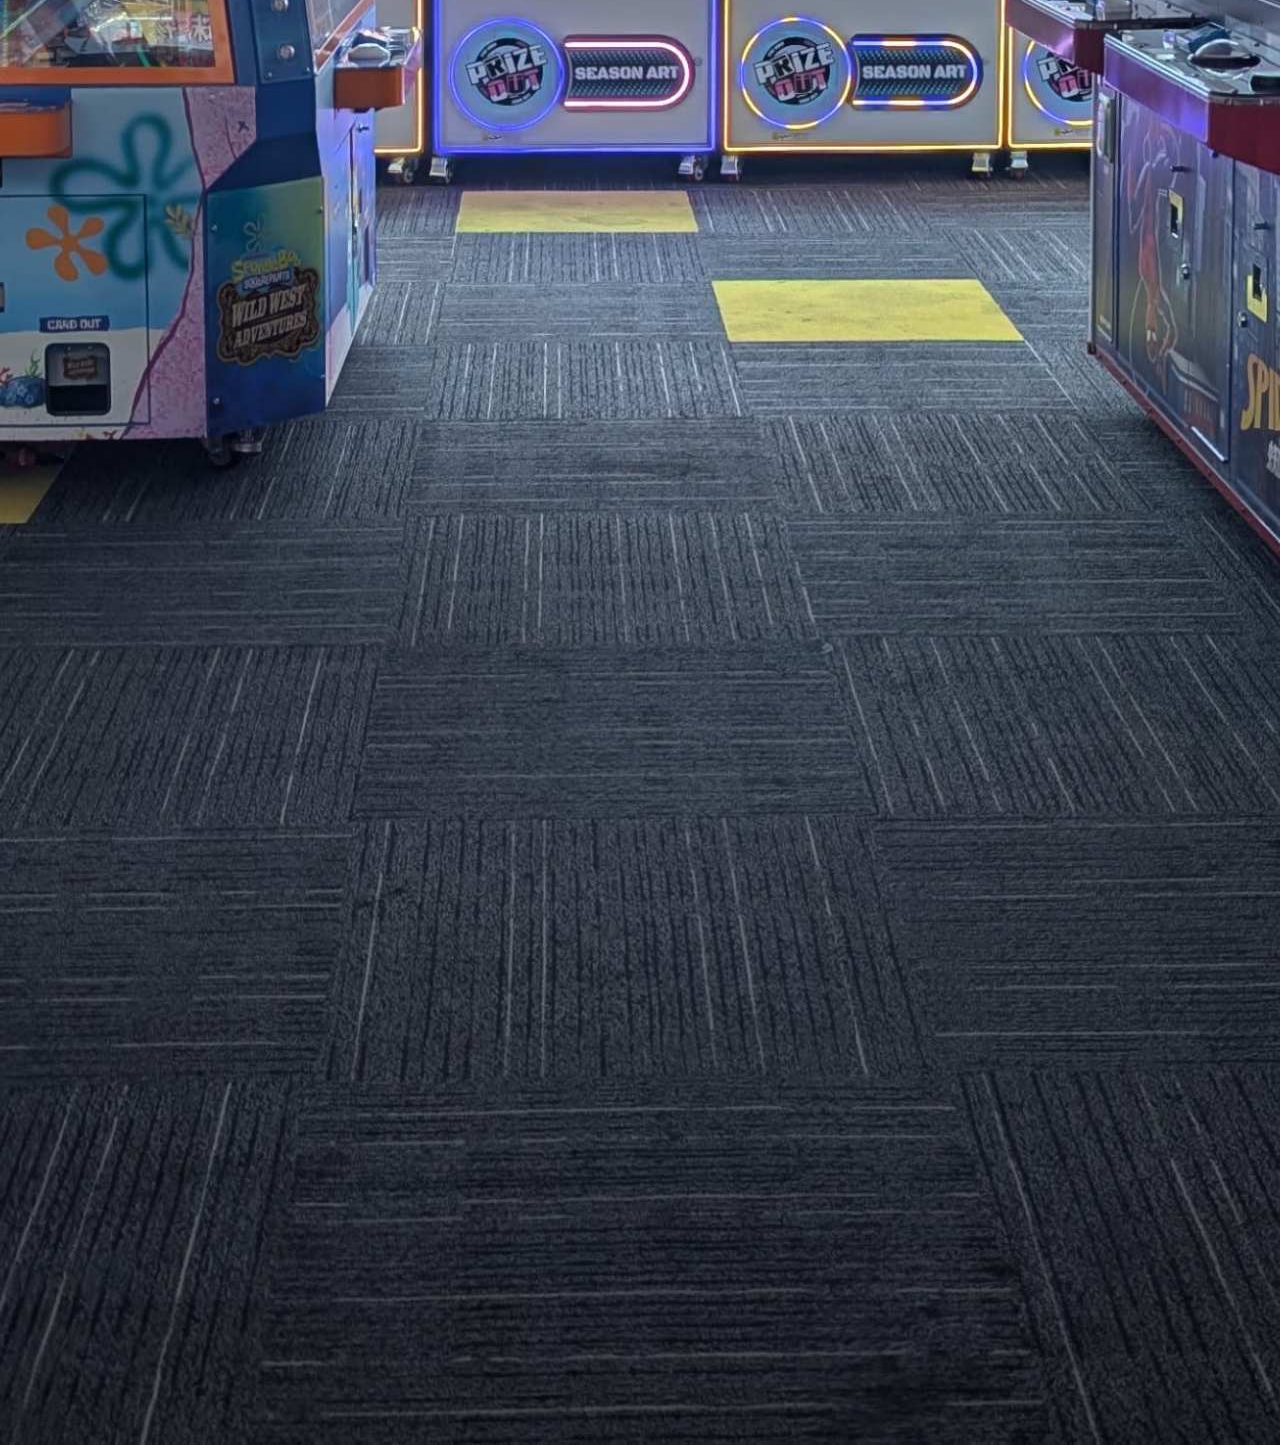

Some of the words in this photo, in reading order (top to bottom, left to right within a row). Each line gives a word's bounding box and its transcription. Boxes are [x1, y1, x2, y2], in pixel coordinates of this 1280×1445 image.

[465, 44, 548, 86] PRIZE
[574, 65, 645, 80] SEASON
[646, 65, 679, 80] ART
[753, 42, 834, 85] PRIZE
[862, 64, 931, 80] SEASON
[933, 64, 967, 79] ART
[483, 68, 540, 103] OUT
[772, 68, 827, 102] OUT
[231, 295, 268, 328] WILD
[269, 283, 308, 314] WEST
[47, 319, 78, 331] CARD
[79, 318, 103, 330] OUT
[233, 309, 308, 350] ADVENTURES
